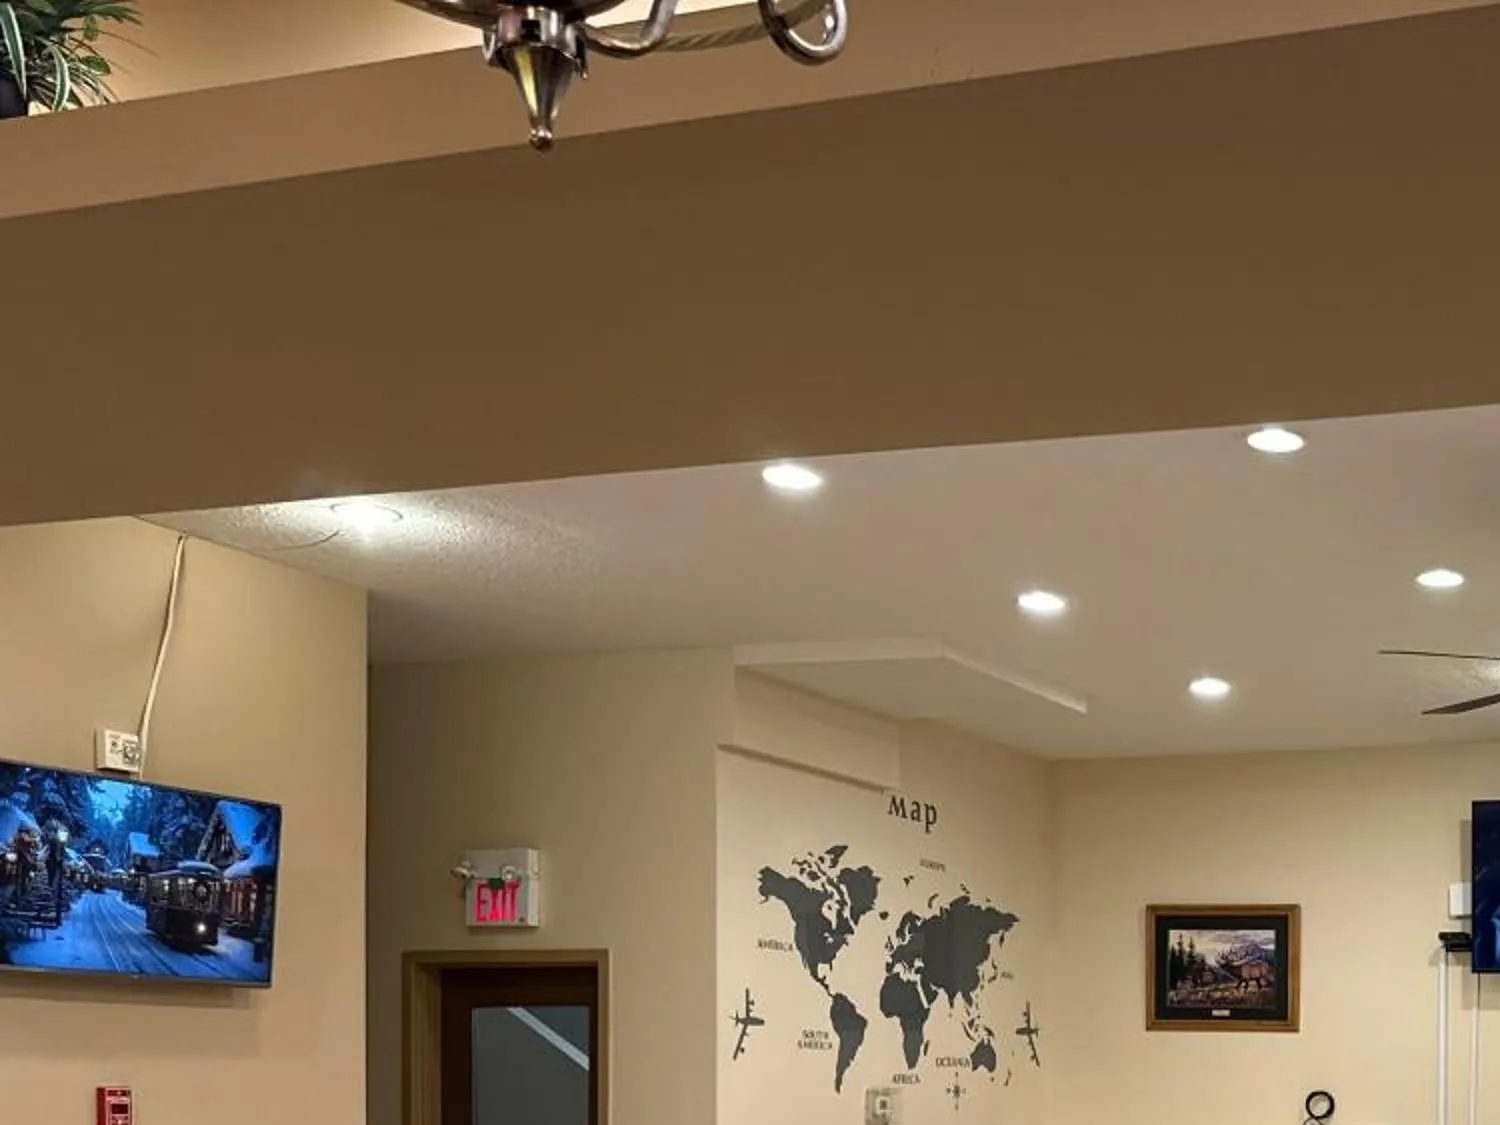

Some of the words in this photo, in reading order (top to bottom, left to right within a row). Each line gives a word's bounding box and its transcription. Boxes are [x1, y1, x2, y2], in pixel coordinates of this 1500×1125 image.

[888, 795, 937, 834] Map
[475, 879, 521, 923] EXIT
[892, 1073, 921, 1084] AFRICA
